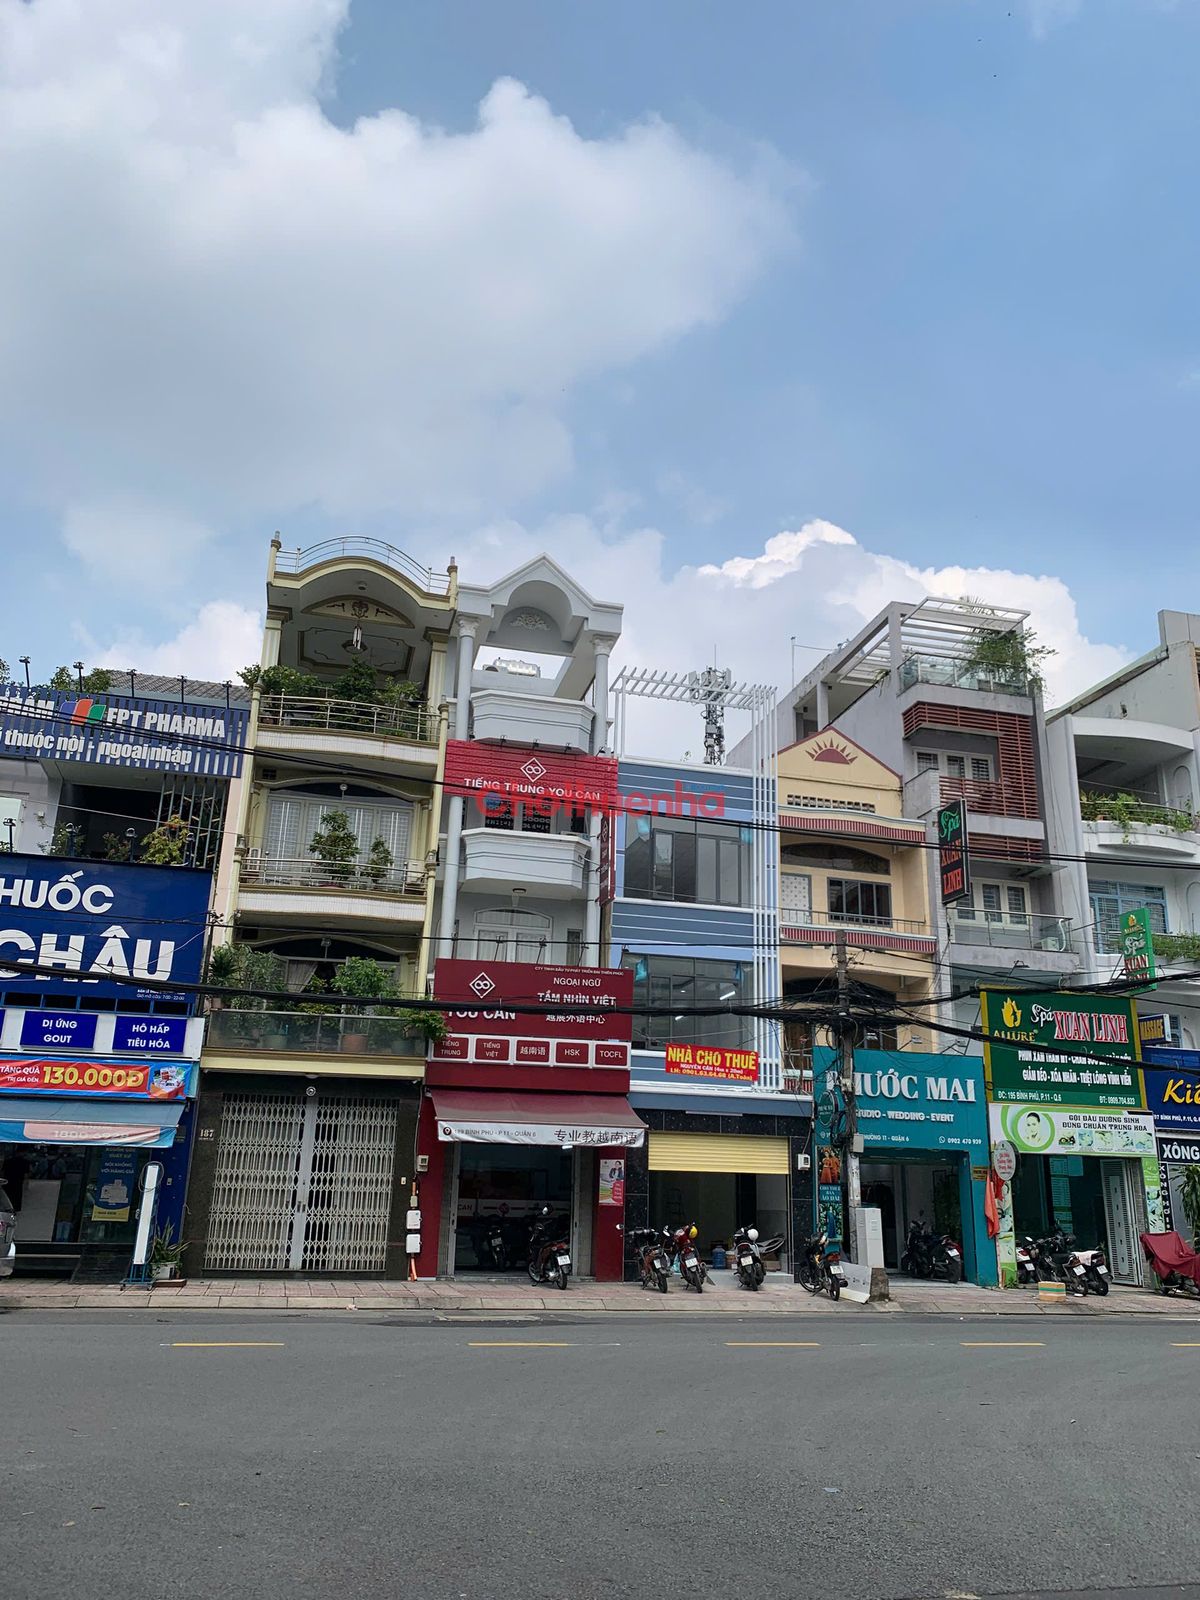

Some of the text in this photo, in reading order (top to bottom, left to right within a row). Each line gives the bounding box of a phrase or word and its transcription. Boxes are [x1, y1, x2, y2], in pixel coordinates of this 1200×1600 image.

[107, 707, 225, 738] FPT PHARMA
[4, 729, 55, 749] thuốc
[57, 735, 85, 754] nội
[98, 740, 148, 761] ngoại
[150, 745, 192, 766] nhập
[464, 777, 600, 800] TIẾNG TRUNG YOU CAN
[940, 808, 960, 841] Spa
[943, 868, 963, 895] LINH
[0, 870, 115, 914] HUỐC
[0, 925, 176, 985] CHÂU
[554, 978, 580, 987] NGOẠI
[564, 993, 589, 1004] NHÌN
[592, 995, 616, 1006] VIỆT
[42, 1018, 77, 1029] DỊ ỨNG
[132, 1023, 170, 1034] HÔ HẤP
[1031, 1004, 1054, 1027] Spa
[1093, 1014, 1129, 1044] LINH
[44, 1034, 72, 1044] GOUT
[127, 1038, 170, 1048] TIÊU HÓA
[600, 1050, 622, 1059] TOCFL
[668, 1045, 756, 1070] NHÀ CHO THUÊ
[0, 1065, 21, 1075] TẶNG
[43, 1066, 144, 1087] 130.000Đ
[1023, 1066, 1036, 1080] GIẢM
[925, 1076, 976, 1102] MAI
[887, 1110, 925, 1121] WEDDING
[931, 1114, 955, 1122] EVENT
[554, 1129, 638, 1145] 专业教越南语
[1162, 1142, 1200, 1160] XÔNG
